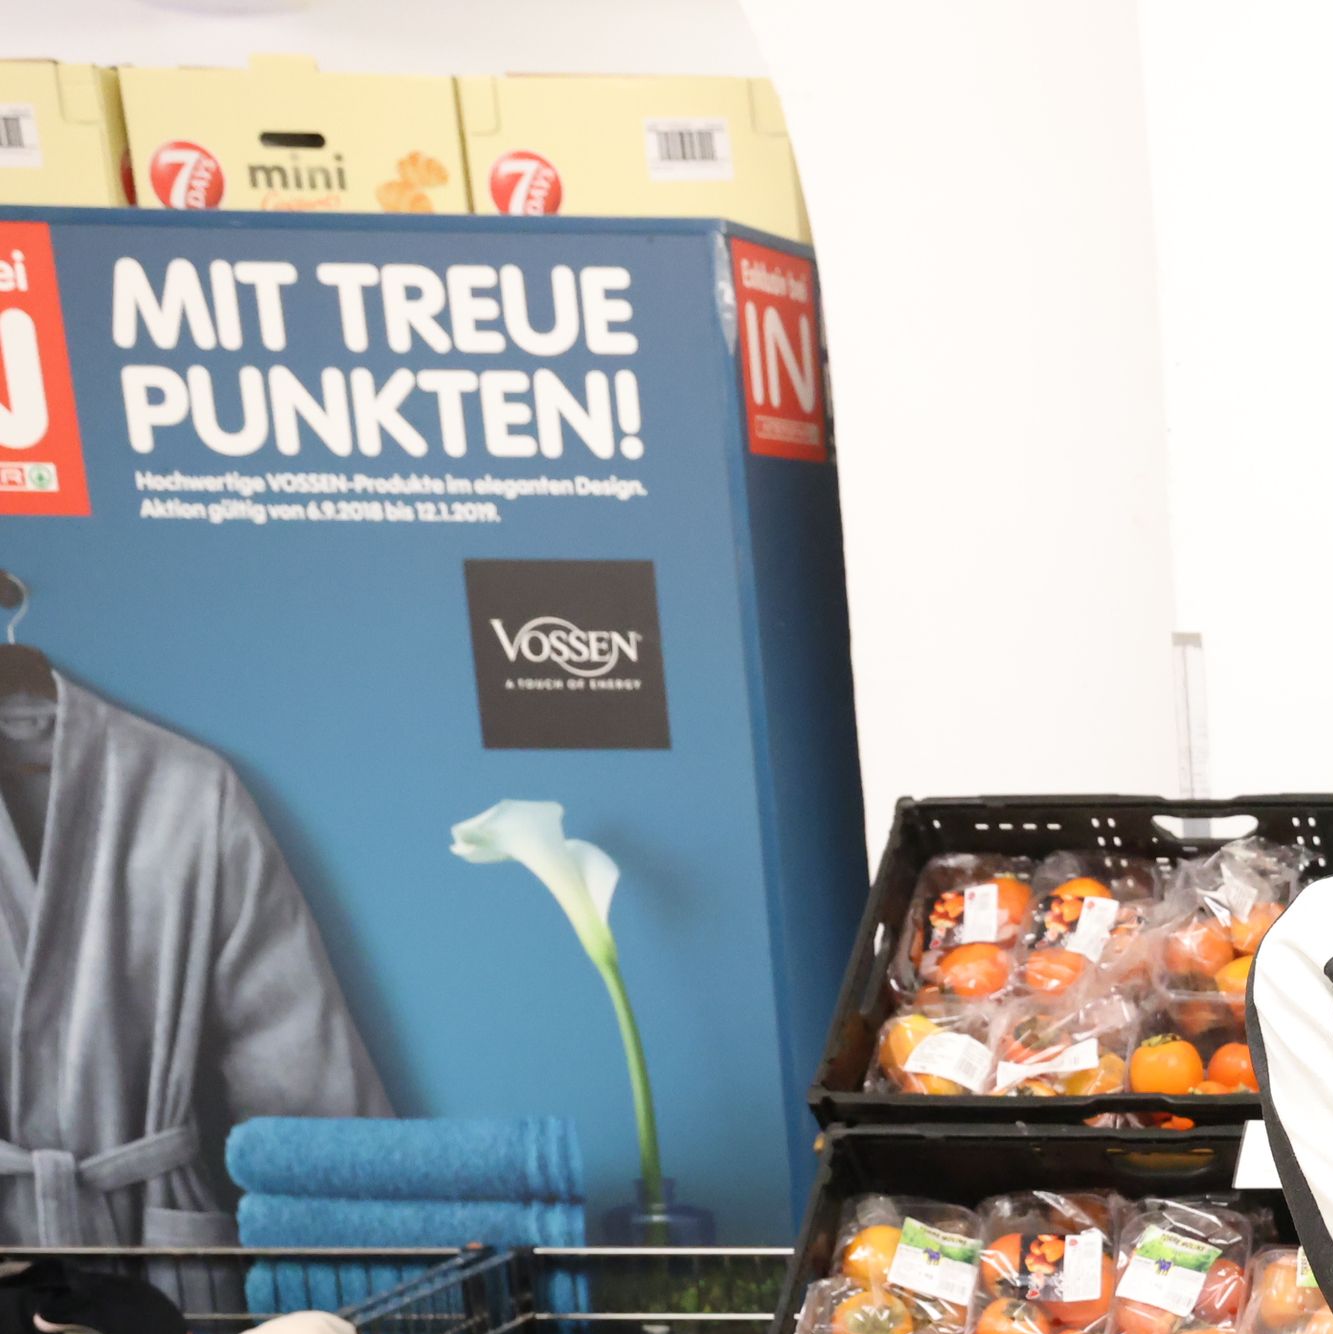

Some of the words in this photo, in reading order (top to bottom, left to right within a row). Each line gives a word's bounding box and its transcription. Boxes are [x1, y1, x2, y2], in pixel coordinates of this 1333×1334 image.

[159, 150, 202, 208] 7
[248, 153, 347, 191] mini
[499, 160, 540, 216] 7
[113, 257, 298, 351] MIT
[316, 262, 638, 356] TREUE
[744, 301, 816, 414] IN
[121, 364, 644, 460] PUNKTEN!
[135, 471, 266, 497] Hochwertige
[445, 473, 472, 494] im
[473, 474, 574, 500] eleganten
[574, 475, 648, 501] Design.
[140, 498, 207, 519] Aktion
[207, 498, 267, 524] gültig
[267, 504, 305, 520] von
[384, 500, 415, 522] bis
[489, 616, 642, 677] VOSSEN
